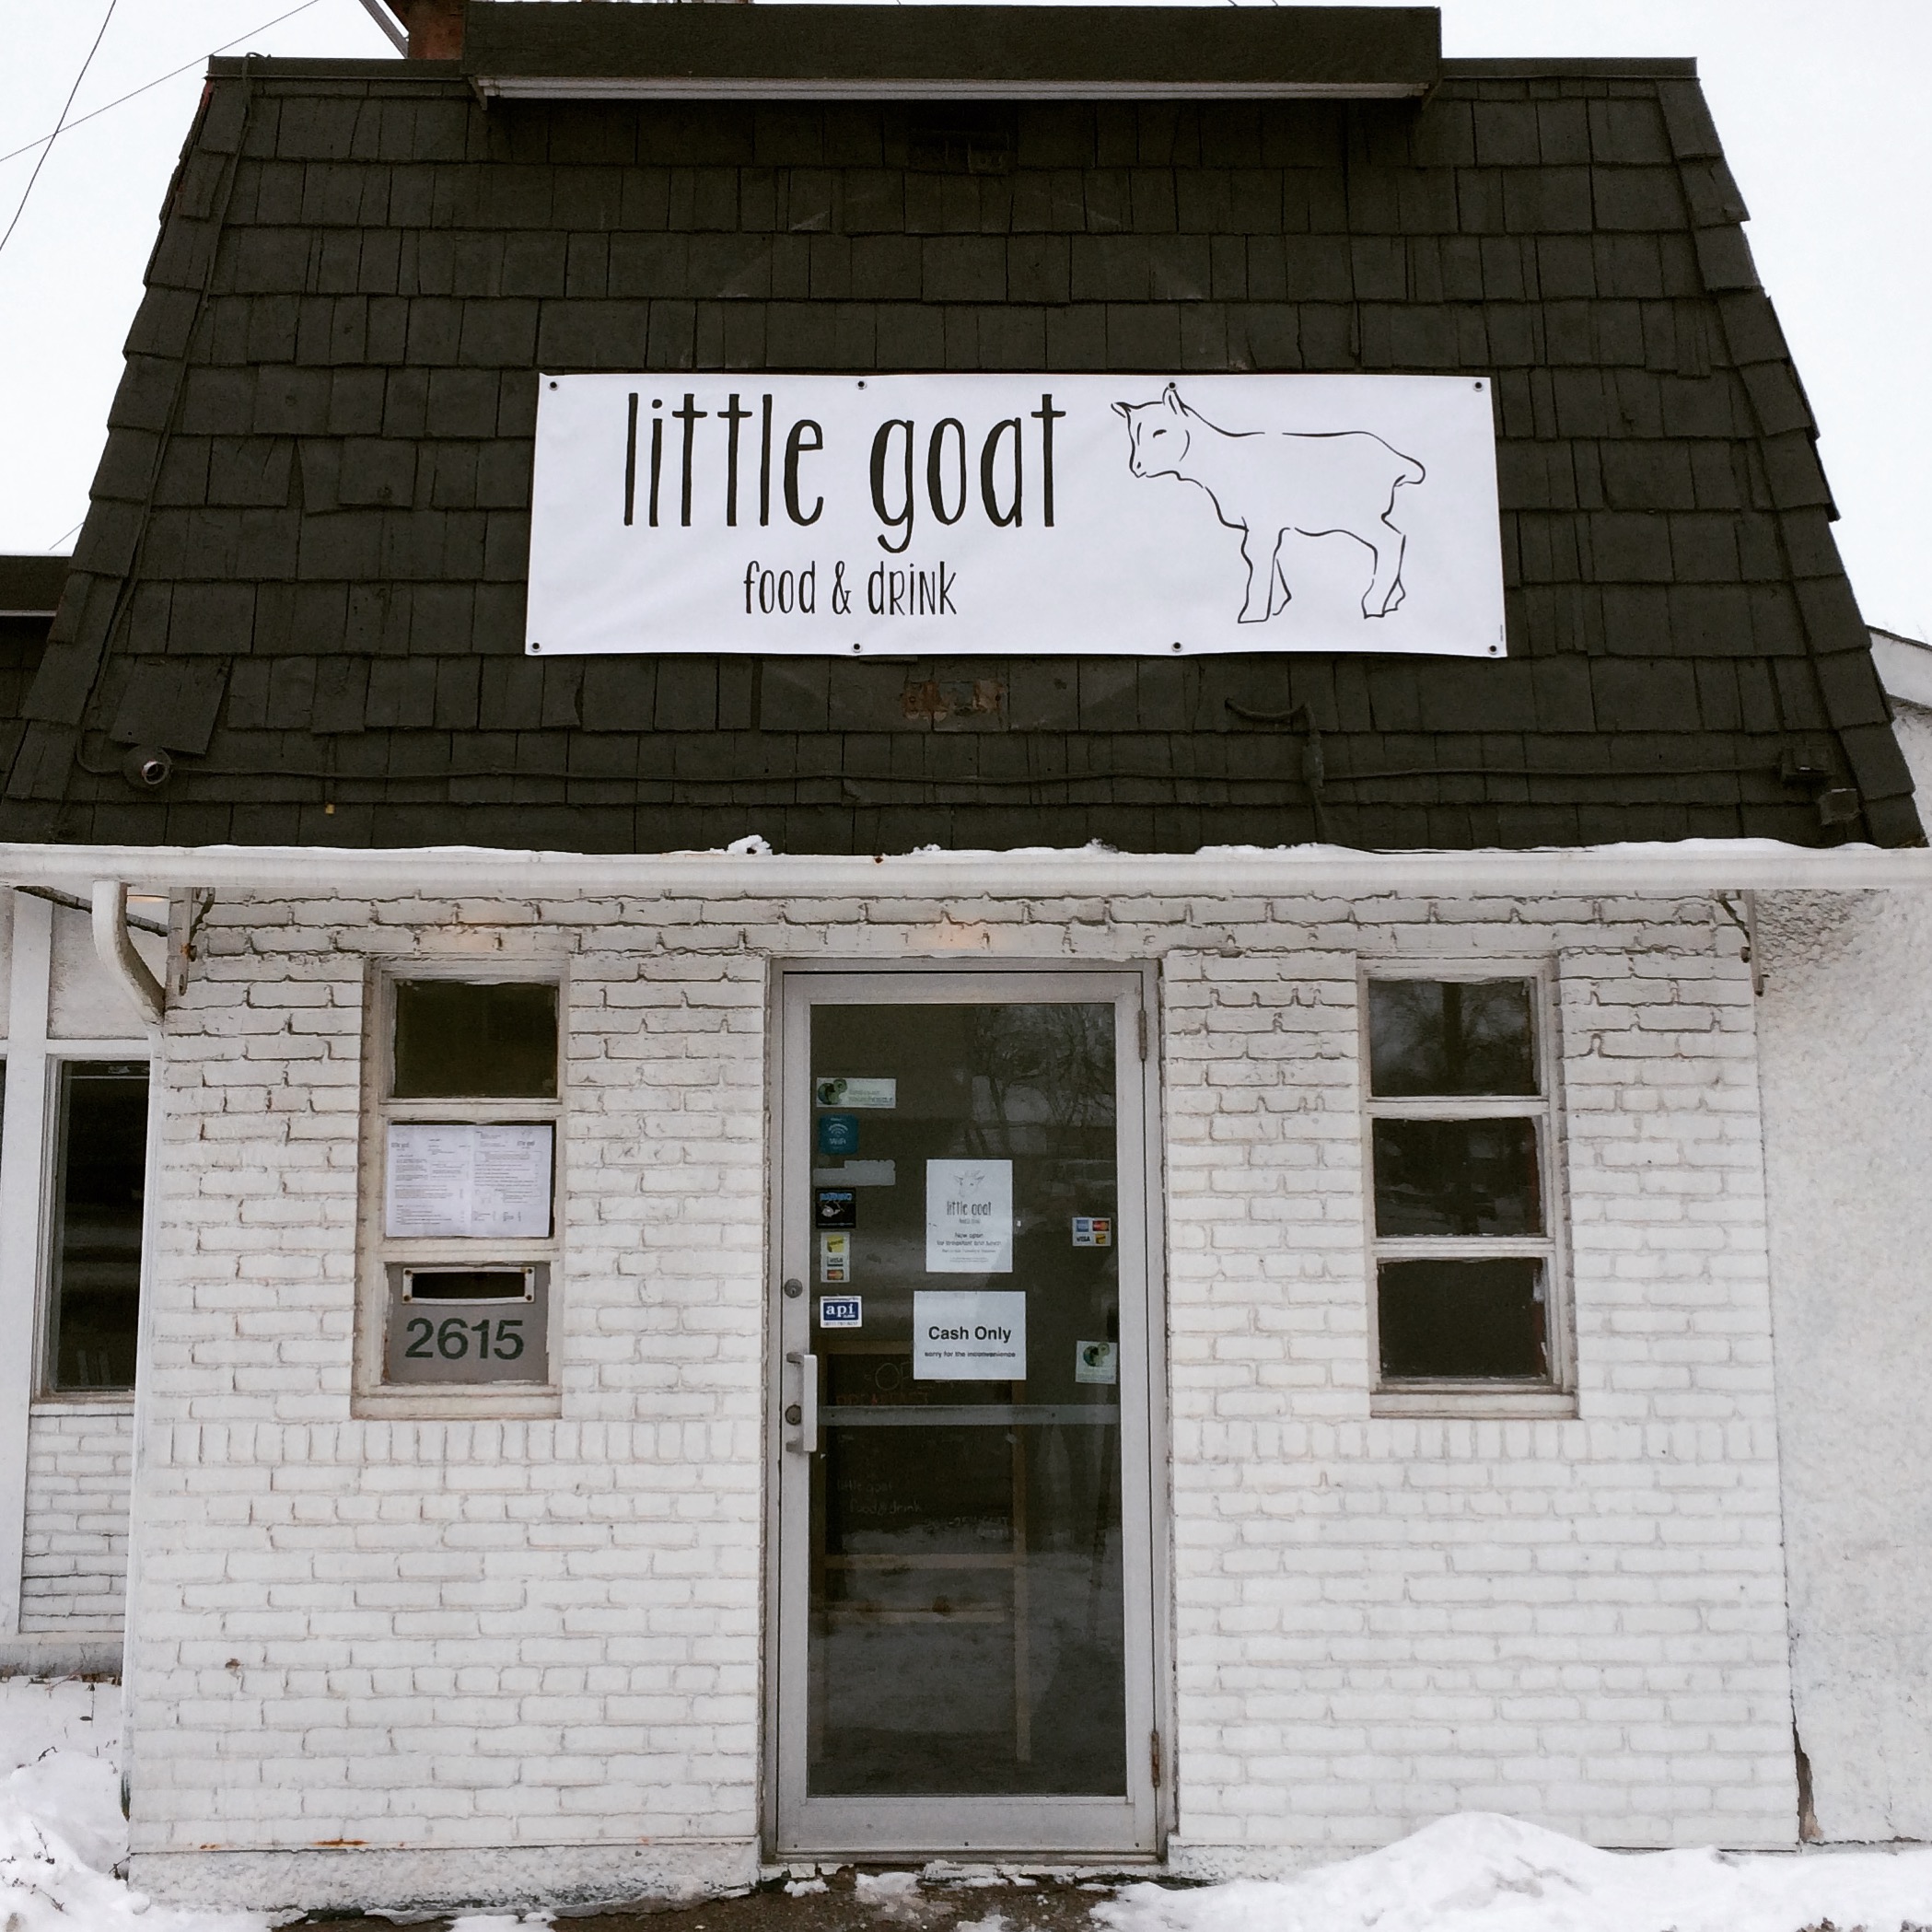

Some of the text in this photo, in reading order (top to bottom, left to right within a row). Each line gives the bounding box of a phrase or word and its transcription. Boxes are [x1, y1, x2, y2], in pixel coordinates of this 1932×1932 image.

[623, 392, 1066, 553] little goat
[742, 560, 816, 614] food
[832, 560, 852, 615] &
[404, 1317, 524, 1361] 2615
[928, 1325, 1012, 1344] Cash Only
